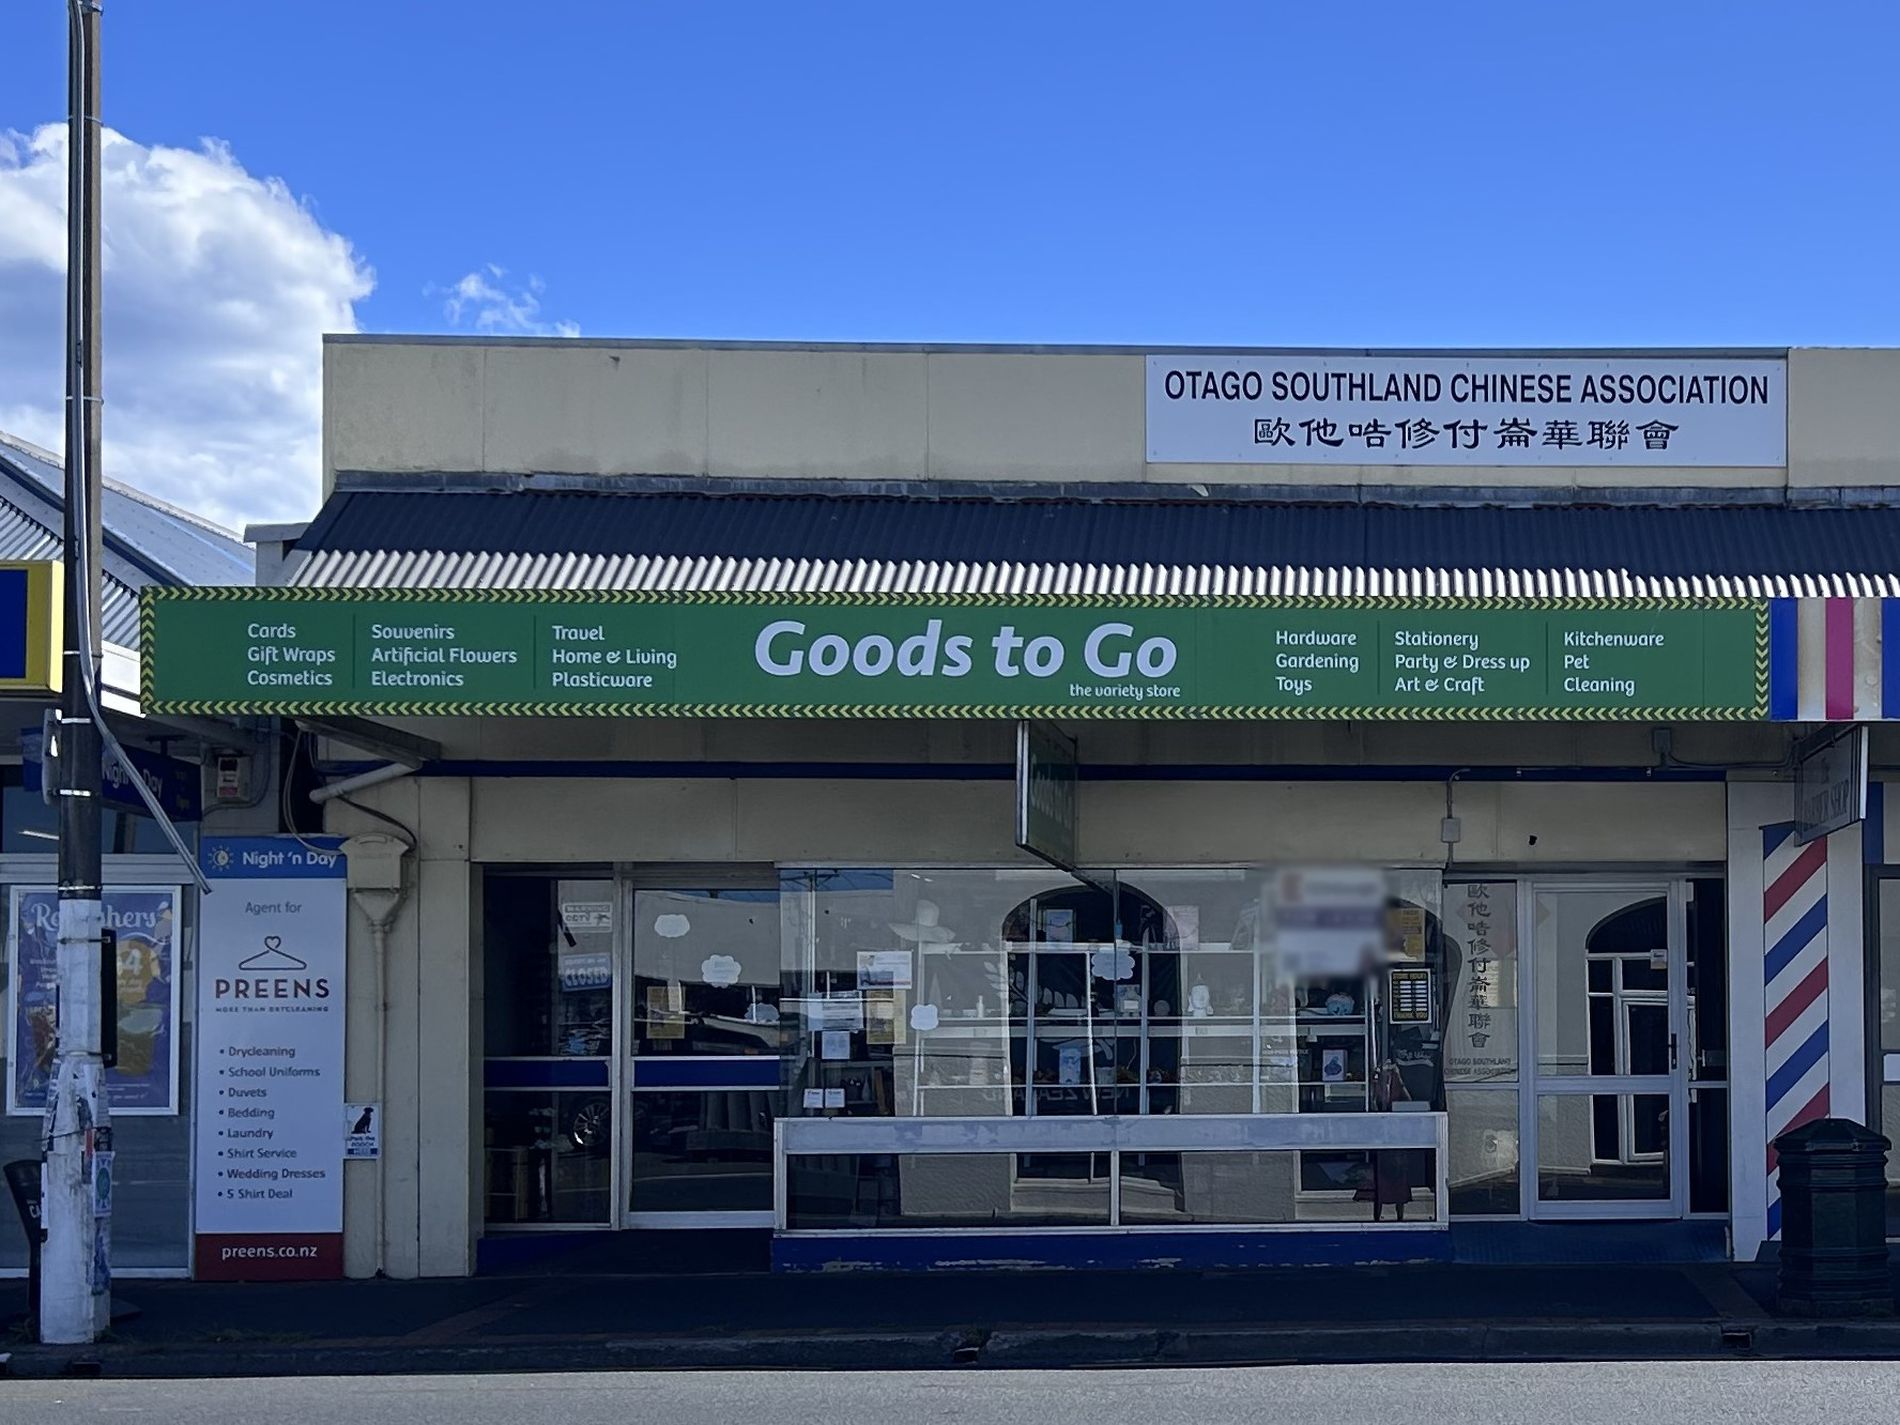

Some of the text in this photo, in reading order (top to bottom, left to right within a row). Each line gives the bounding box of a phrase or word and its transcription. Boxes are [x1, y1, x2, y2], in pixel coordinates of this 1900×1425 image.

[1164, 370, 1769, 404] OTAGO SOUTHLAND CHINESE ASSOCIATION
[247, 622, 297, 640] Cards
[371, 623, 455, 641] Souvenirs
[552, 625, 605, 641] Travel
[1275, 630, 1357, 647] Hardware
[1564, 631, 1665, 648] Kitchenware
[755, 619, 1178, 679] Goods to Go
[1394, 630, 1479, 651] Stationery
[247, 646, 336, 666] Gift Wraps
[371, 646, 518, 664] Artificial Flowers
[552, 648, 677, 669] Home & Living
[1275, 653, 1360, 673] Gardening
[1394, 653, 1531, 674] Party & Dress up
[1564, 654, 1590, 670] Pet
[247, 669, 333, 687] Cosmetics
[371, 670, 464, 687] Electronics
[552, 672, 653, 688] Plasticware
[1275, 676, 1313, 696] Toys
[1394, 676, 1485, 696] Art & Craft
[1564, 677, 1636, 697] Cleaning
[1069, 683, 1181, 701] the variety store
[242, 851, 284, 868] Night
[306, 851, 337, 868] Day
[31, 902, 156, 931] Rehers
[245, 902, 303, 915] Agent for
[564, 966, 609, 986] CLOSED
[215, 978, 330, 999] PREENS
[228, 1046, 296, 1059] Drycleaning
[228, 1066, 320, 1078] School Uniforms
[228, 1087, 267, 1098] Duvets
[228, 1107, 275, 1119] Bedding
[227, 1128, 273, 1140] Laundry
[227, 1147, 297, 1159] Shirt Service
[227, 1168, 326, 1181] Wedding Dresses
[238, 1188, 265, 1199] Shirt
[268, 1188, 293, 1199] Deal
[221, 1246, 318, 1260] preens.co.nz
